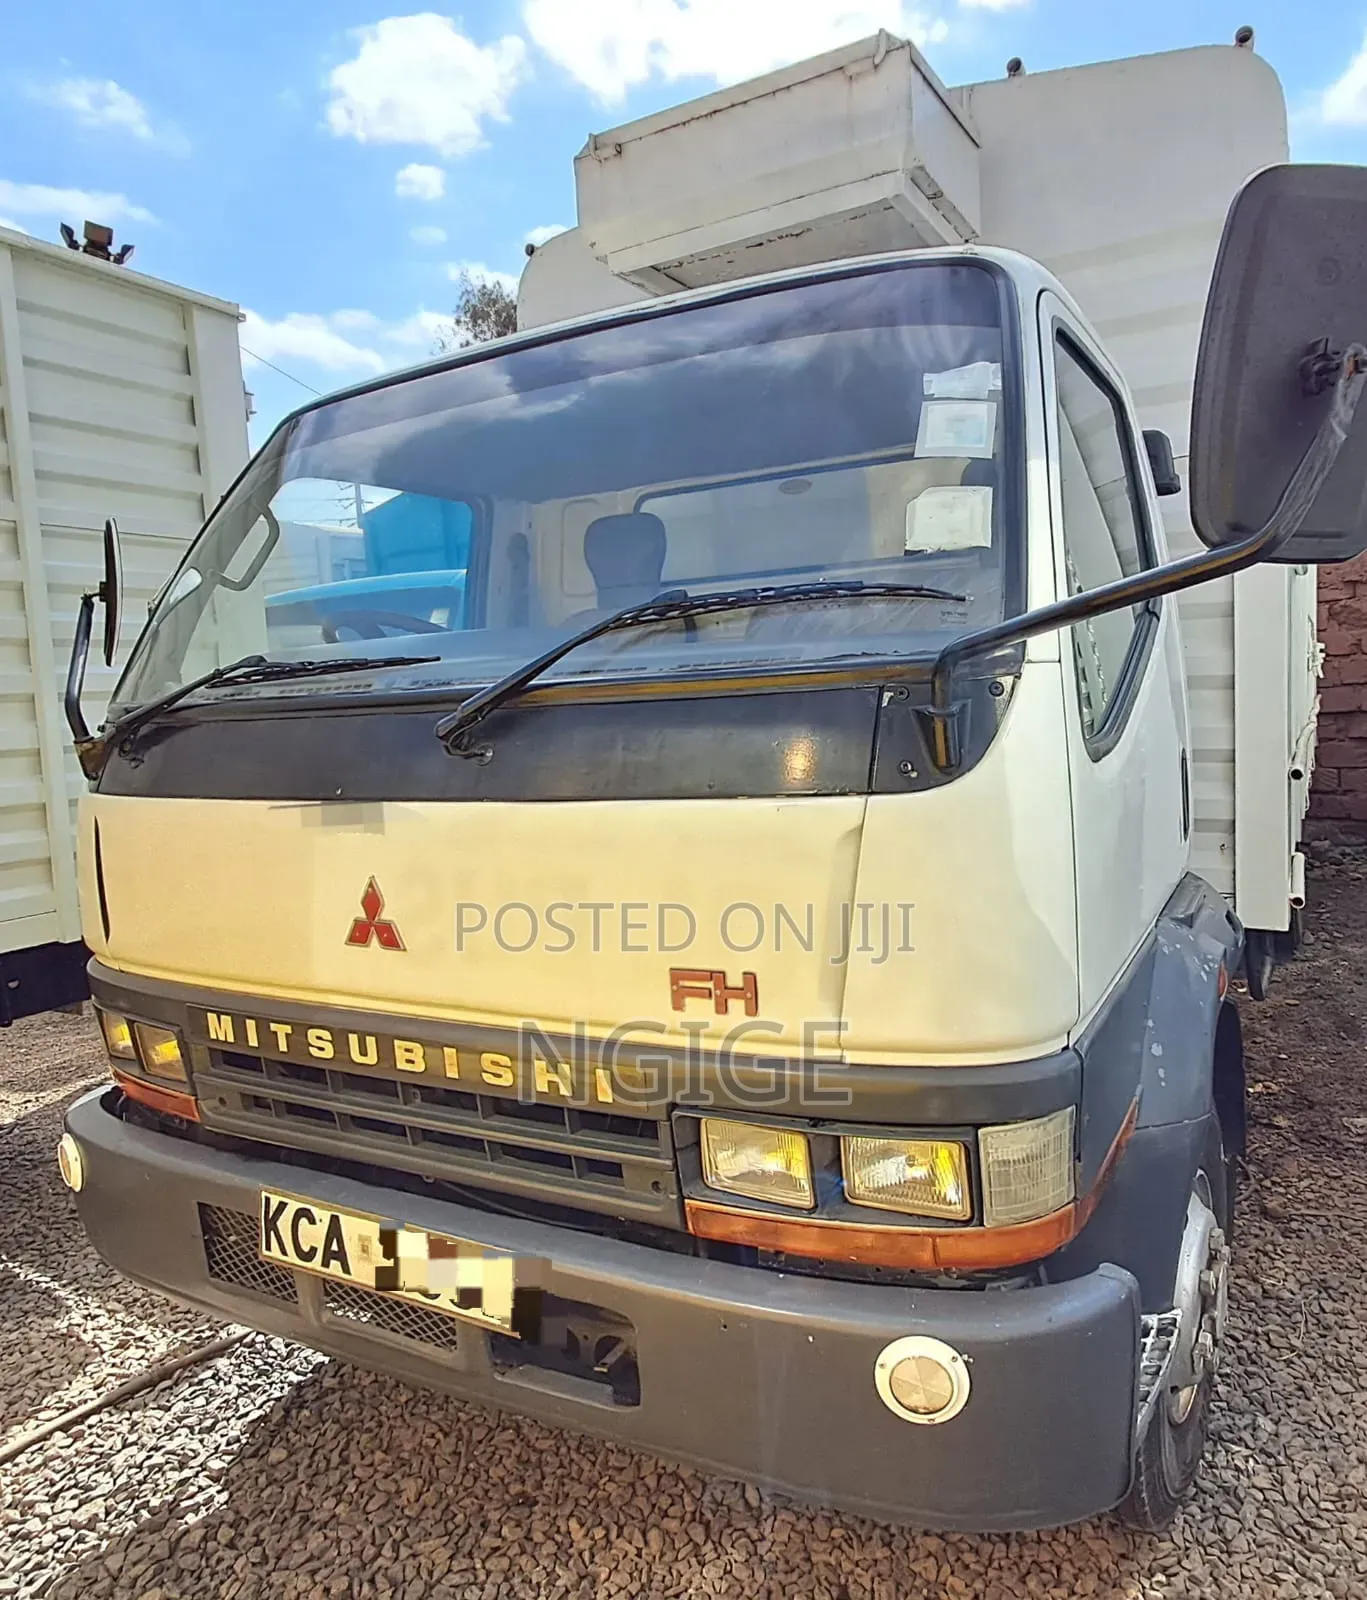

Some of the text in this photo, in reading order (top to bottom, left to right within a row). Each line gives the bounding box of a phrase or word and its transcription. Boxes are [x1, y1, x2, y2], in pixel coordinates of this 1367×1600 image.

[669, 967, 759, 1016] FH
[206, 1012, 616, 1104] MITSUBISHI
[264, 1196, 352, 1276] KCA
